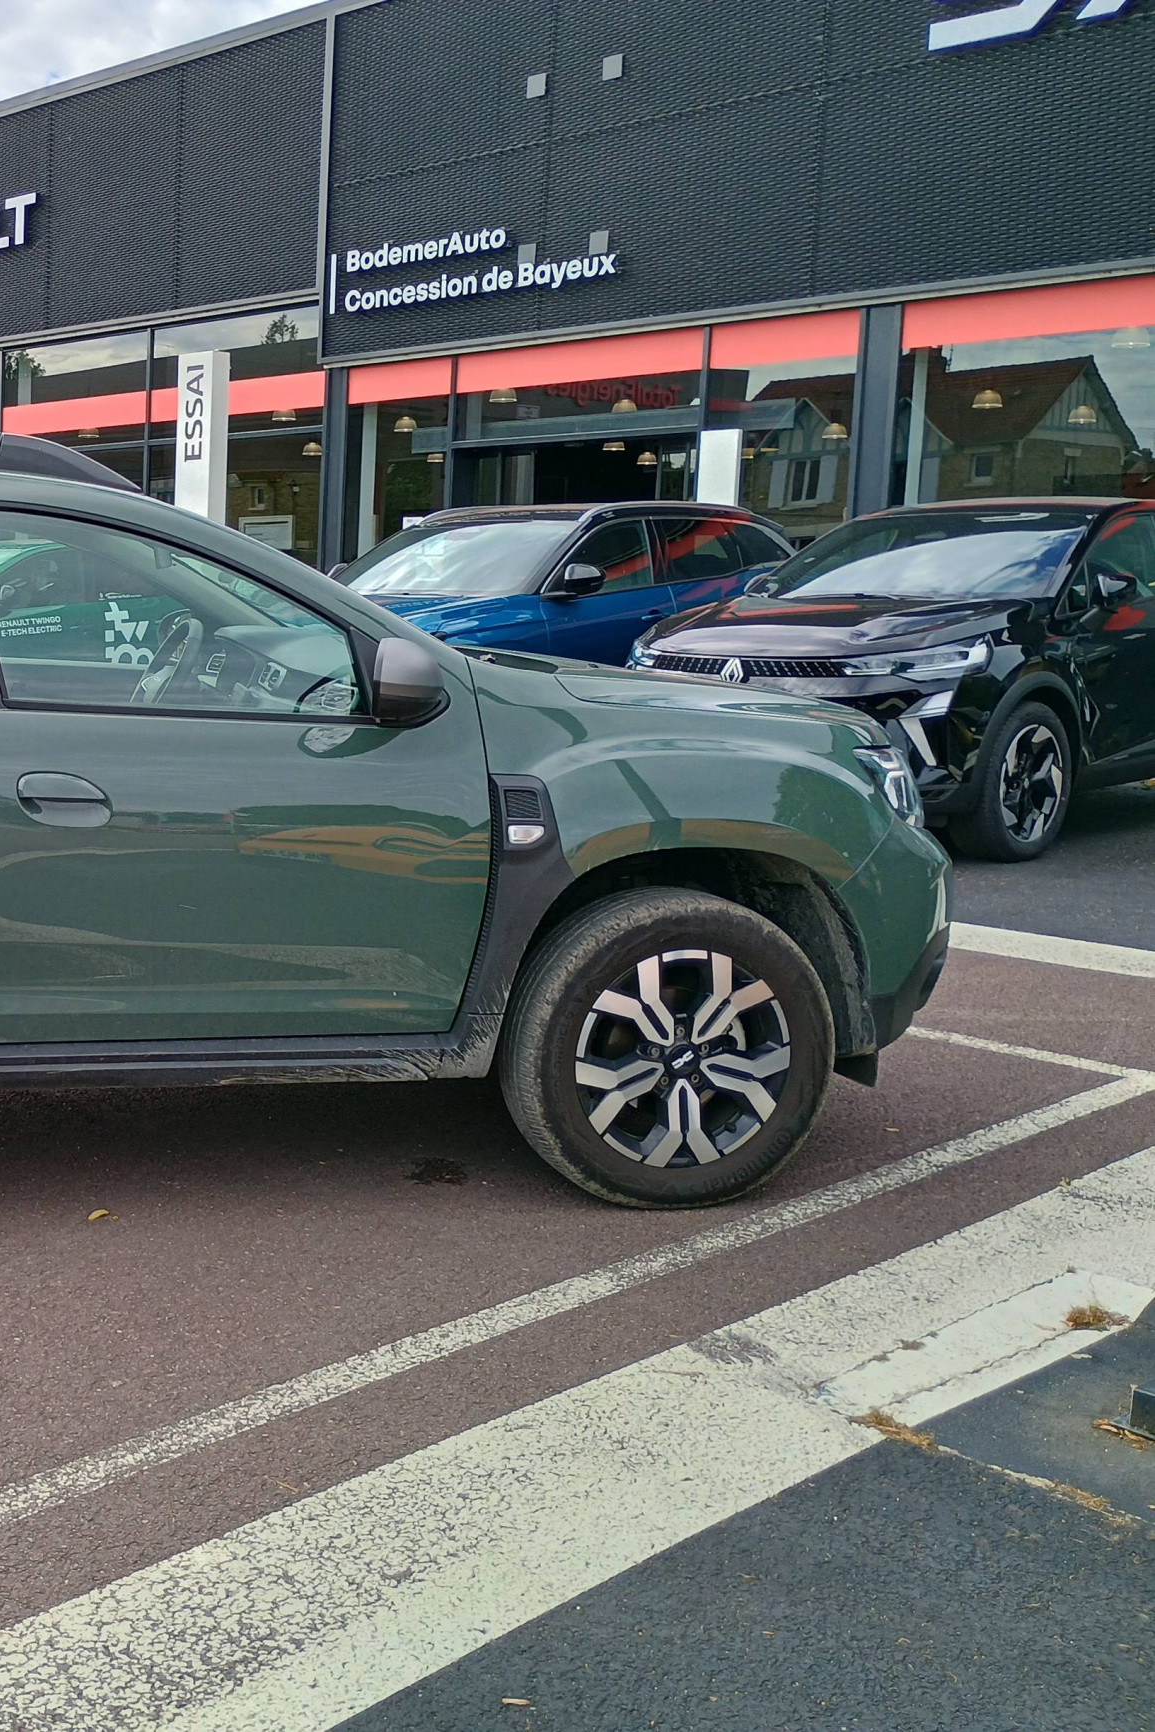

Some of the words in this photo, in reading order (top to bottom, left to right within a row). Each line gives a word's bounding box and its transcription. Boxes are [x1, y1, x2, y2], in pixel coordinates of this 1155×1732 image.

[346, 227, 506, 273] BodemerAuto
[345, 272, 478, 313] Concession
[482, 265, 513, 291] de
[518, 253, 616, 289] Bayeux
[184, 364, 204, 462] ESSAI
[0, 627, 28, 638] E-TECH
[28, 624, 63, 635] ELECTRIC
[30, 615, 62, 625] TWINGO
